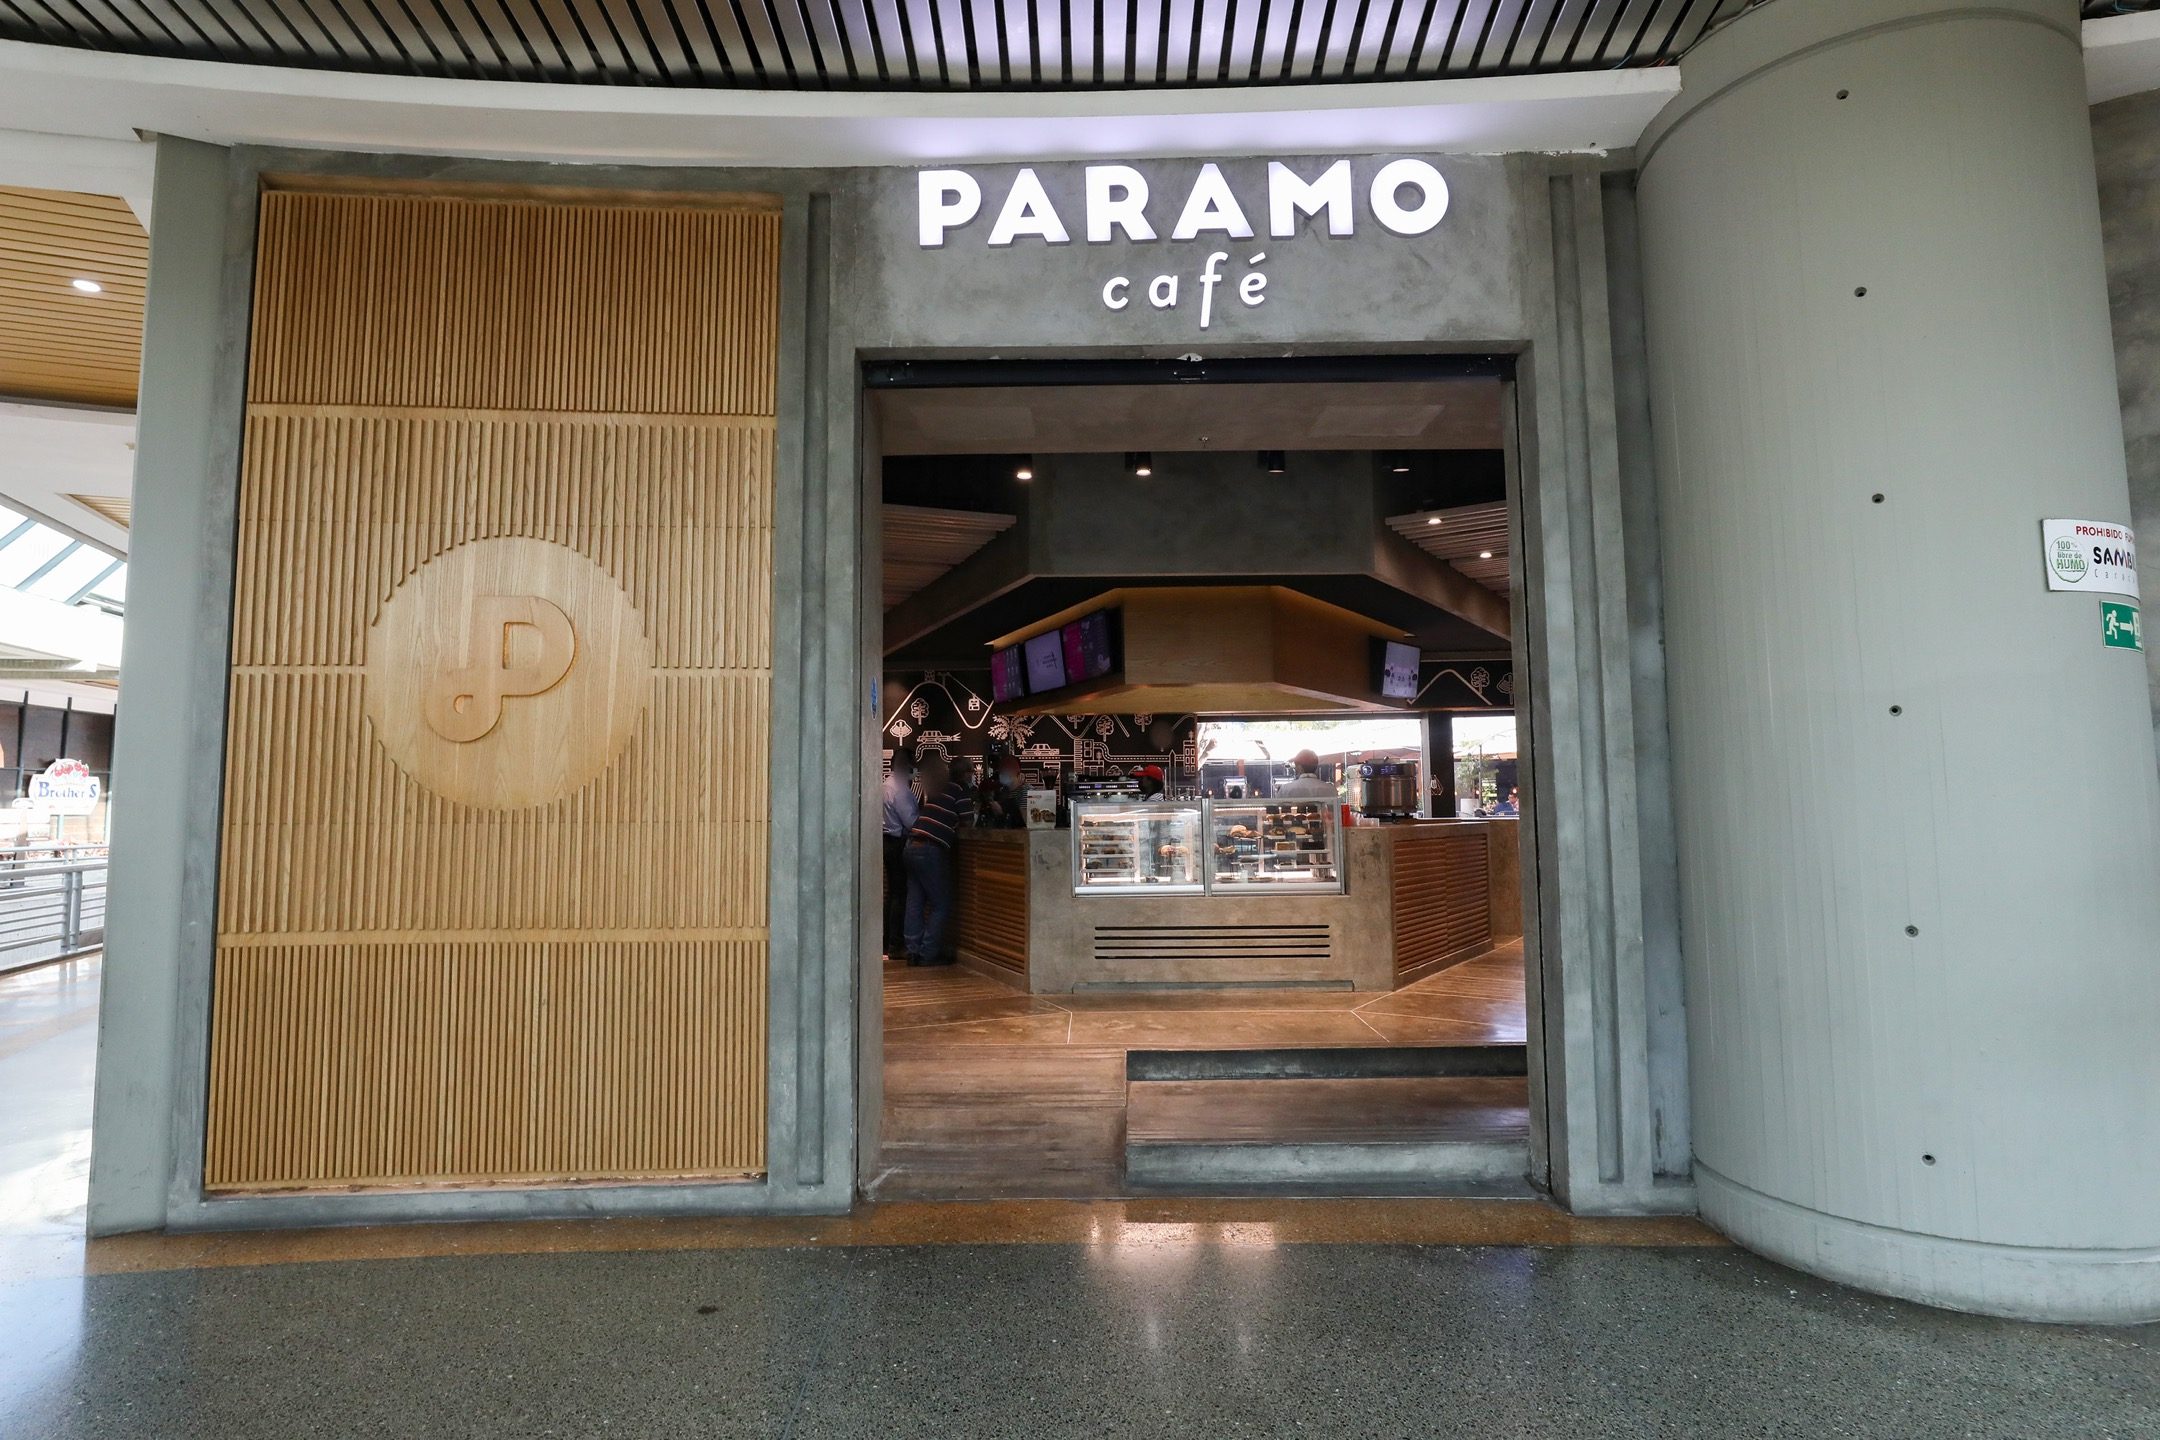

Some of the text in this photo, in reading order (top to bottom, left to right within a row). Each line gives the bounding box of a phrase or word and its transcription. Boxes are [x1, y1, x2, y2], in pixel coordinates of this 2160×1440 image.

[917, 158, 1450, 249] PARAMO
[1102, 251, 1268, 331] café
[2075, 525, 2123, 540] PROHIBIDO
[2057, 551, 2083, 560] libre de
[2057, 558, 2086, 570] HUMO
